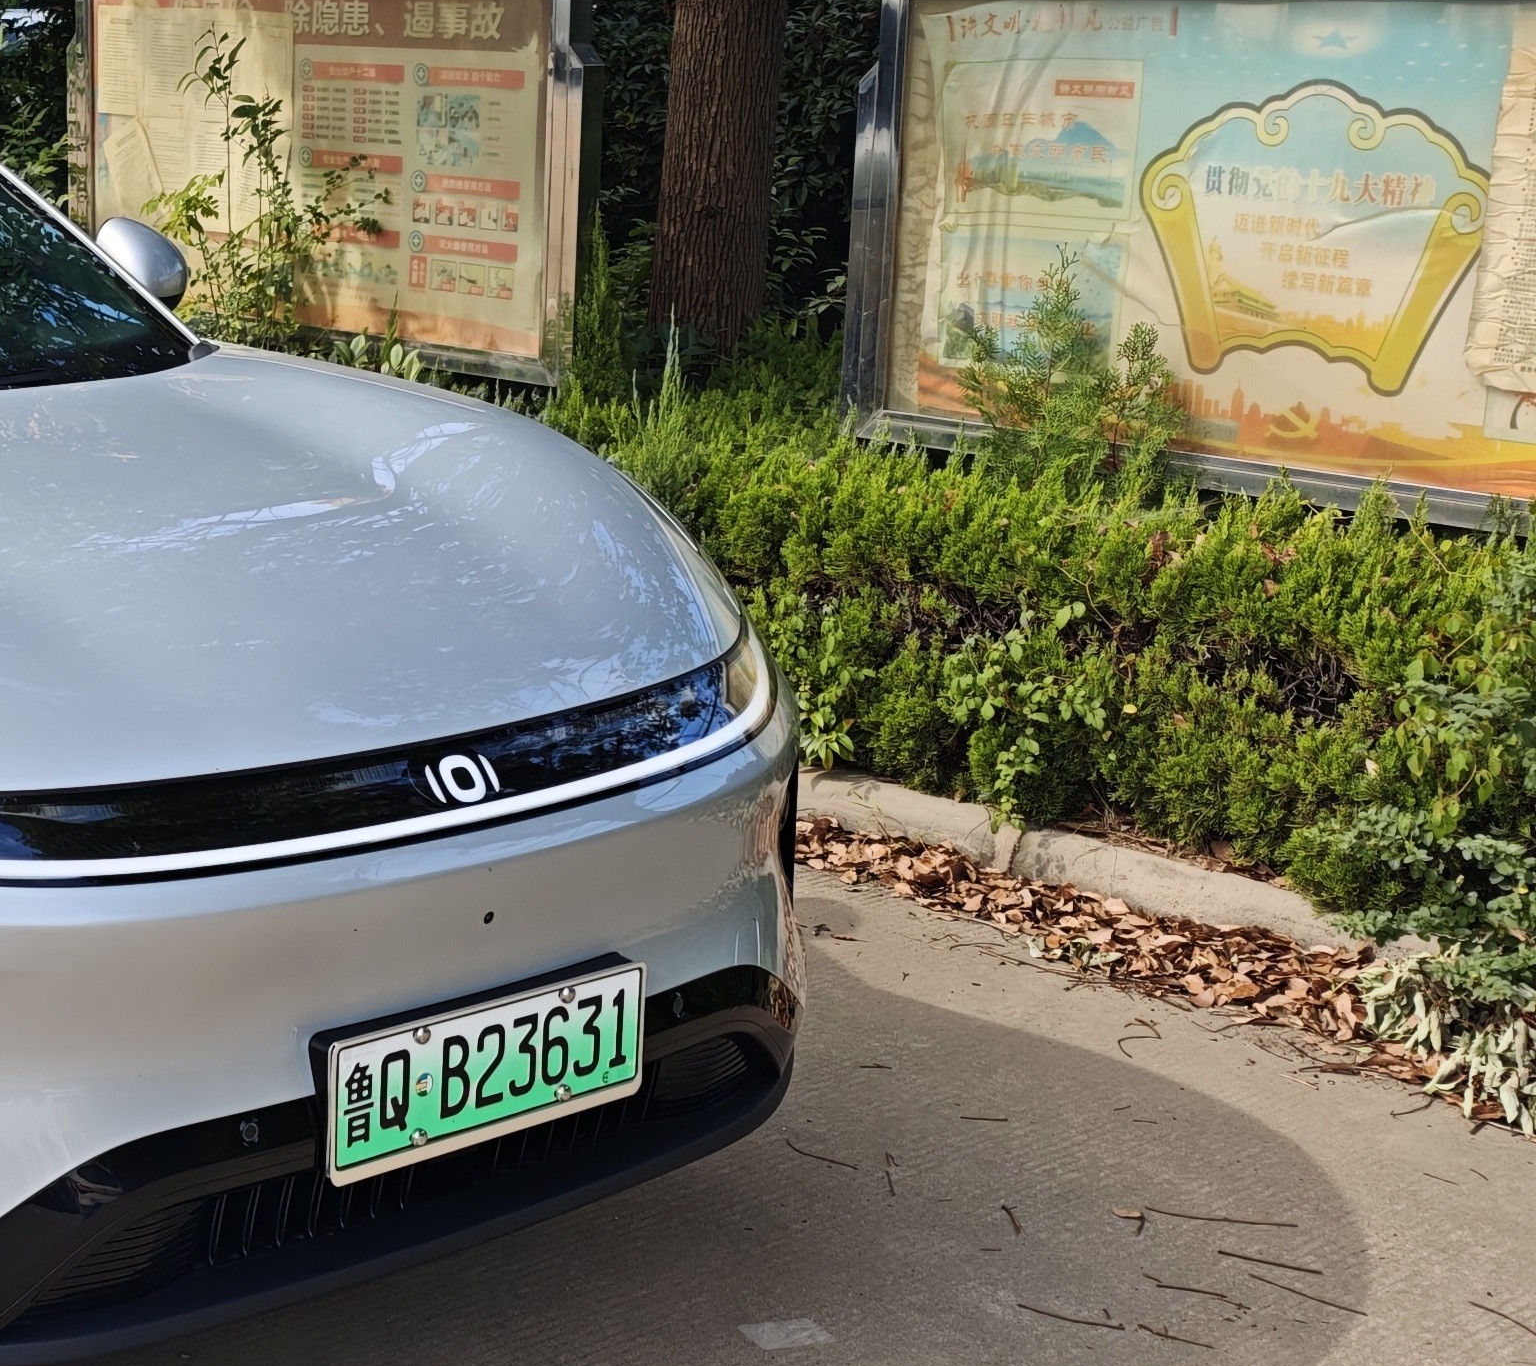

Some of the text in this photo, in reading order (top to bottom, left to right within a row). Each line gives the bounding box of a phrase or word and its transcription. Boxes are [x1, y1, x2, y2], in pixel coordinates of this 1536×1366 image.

[1108, 15, 1164, 32] 公益广告
[1204, 164, 1436, 207] 贯彻党的十九大精神
[1233, 212, 1321, 235] 迈进新时代
[1260, 241, 1350, 269] 开启新征程
[1282, 270, 1374, 297] 续写新篇章
